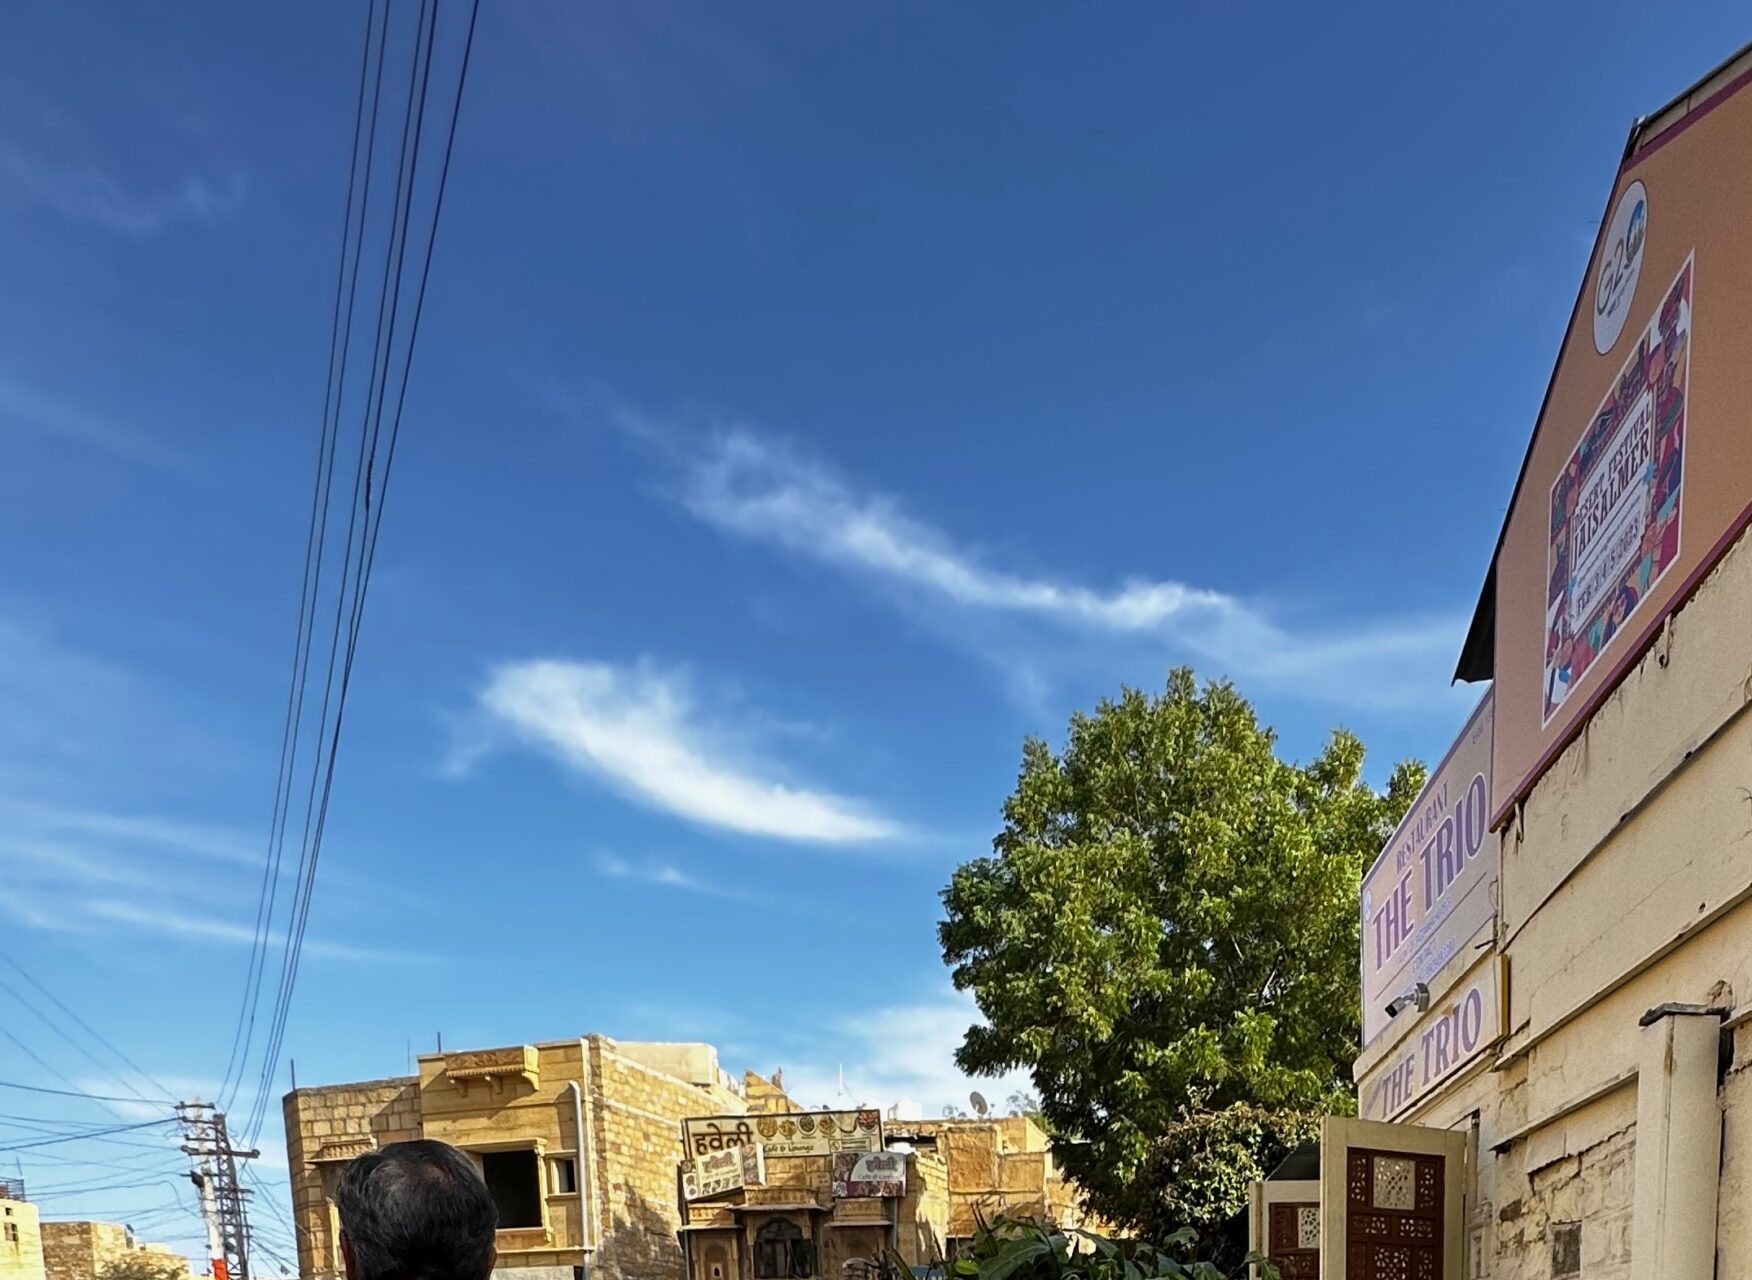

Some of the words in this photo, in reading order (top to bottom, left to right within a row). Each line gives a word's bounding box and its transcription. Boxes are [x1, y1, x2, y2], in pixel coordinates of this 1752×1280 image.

[1573, 427, 1650, 572] JAISALMER
[1574, 471, 1605, 531] DESERT
[1608, 402, 1651, 479] FESTIVAL
[1373, 868, 1414, 973] THE
[1420, 773, 1486, 915] TRIO
[1396, 779, 1449, 874] RESTAURANT
[1382, 1053, 1415, 1119] THE
[1422, 987, 1482, 1087] TRIO
